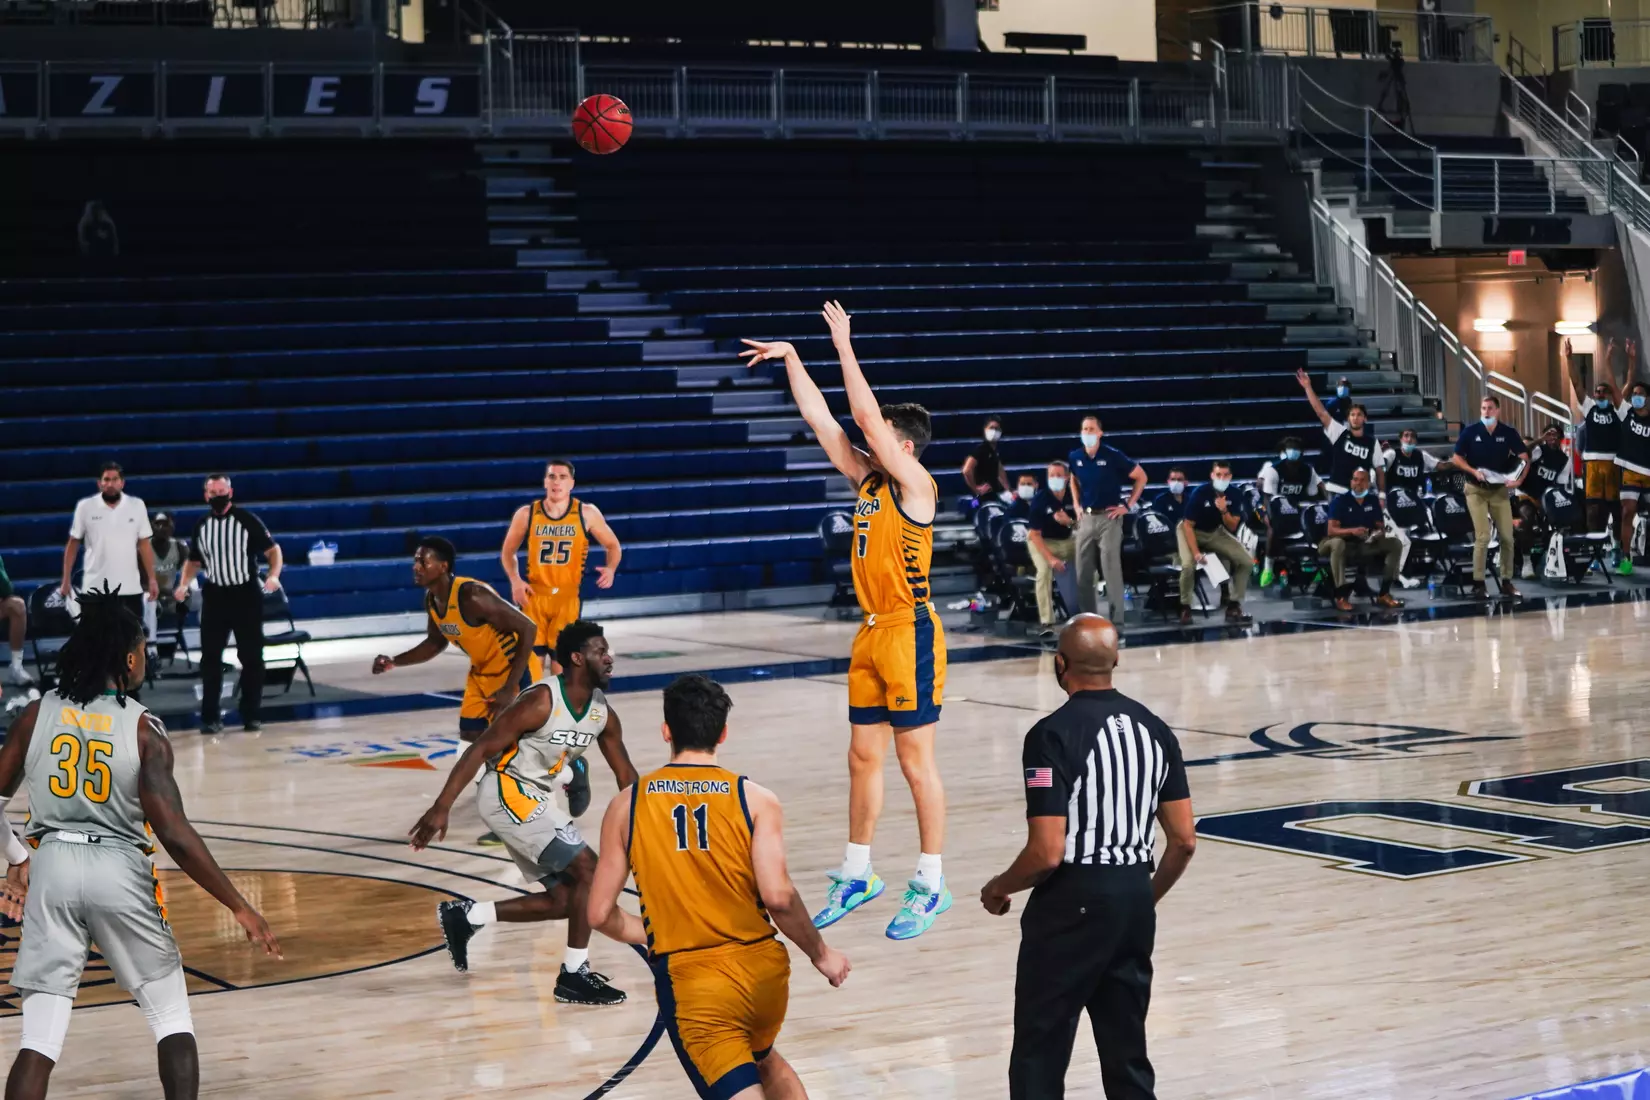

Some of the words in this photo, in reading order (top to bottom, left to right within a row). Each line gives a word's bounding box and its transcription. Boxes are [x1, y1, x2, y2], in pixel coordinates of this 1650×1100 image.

[1593, 411, 1613, 425] CBU
[1344, 440, 1369, 459] CBU
[1396, 465, 1418, 477] CBU
[1281, 485, 1303, 495] CBU
[535, 525, 577, 537] LANCERS
[538, 540, 574, 566] 25
[49, 733, 113, 804] 35
[646, 780, 731, 796] ARMSTRONG
[671, 803, 710, 851] 11
